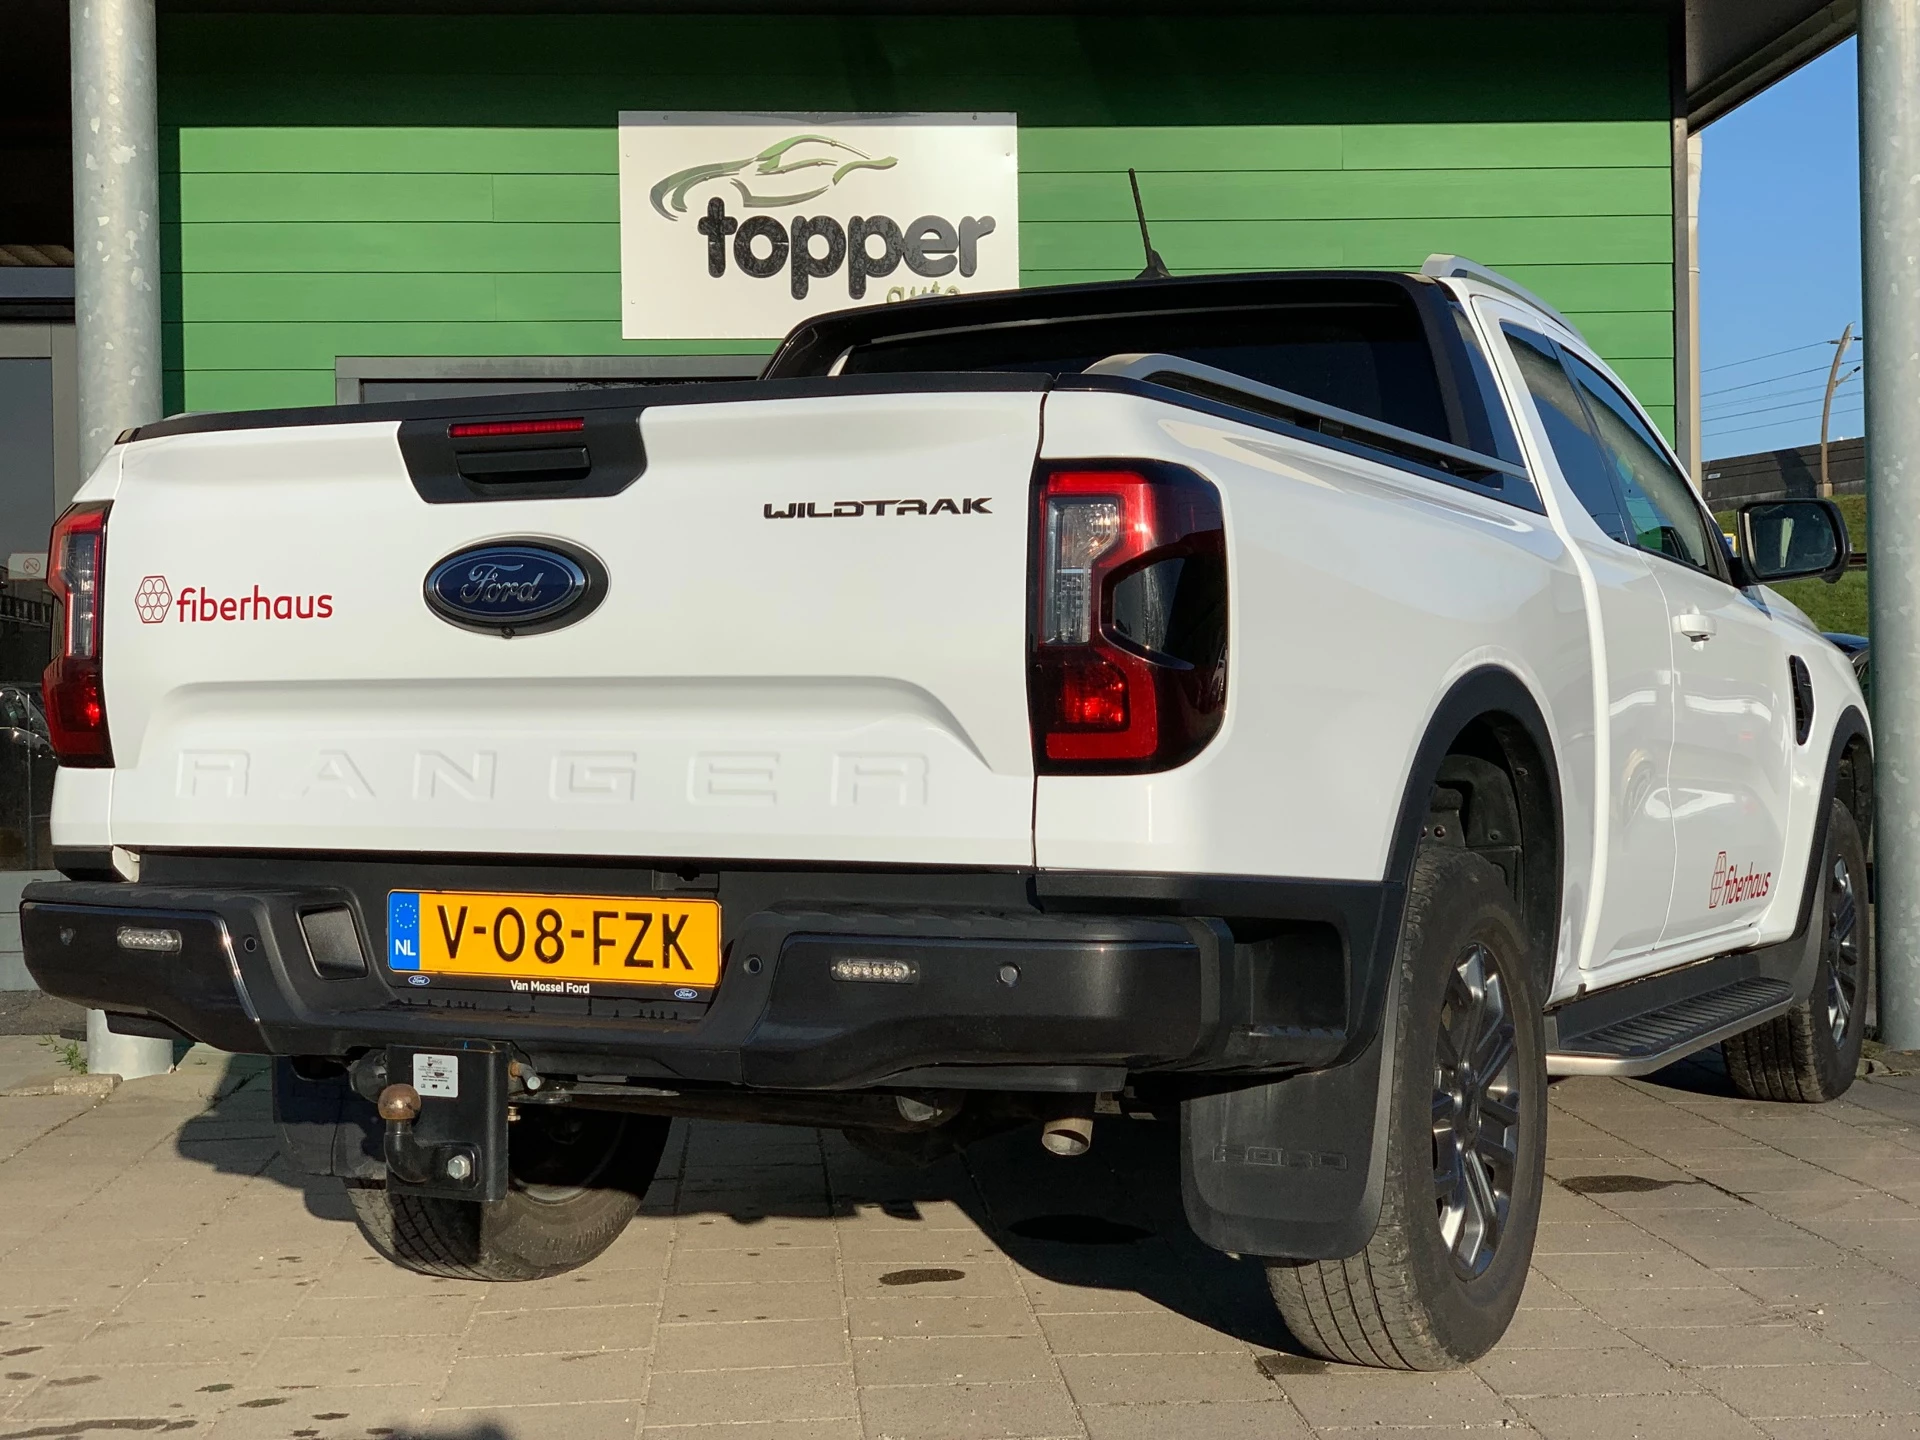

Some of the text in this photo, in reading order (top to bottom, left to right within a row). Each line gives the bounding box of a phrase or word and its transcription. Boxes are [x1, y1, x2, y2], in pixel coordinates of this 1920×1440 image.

[697, 196, 997, 301] topper
[763, 497, 993, 519] WILDTRAK
[460, 563, 544, 603] Ford
[176, 585, 333, 622] fiberhaus
[175, 748, 930, 807] RANGER
[1721, 861, 1771, 906] fiberhaus
[395, 939, 416, 957] NL
[437, 904, 694, 971] V-08-FZK
[510, 979, 590, 995] Van Mossel Ford
